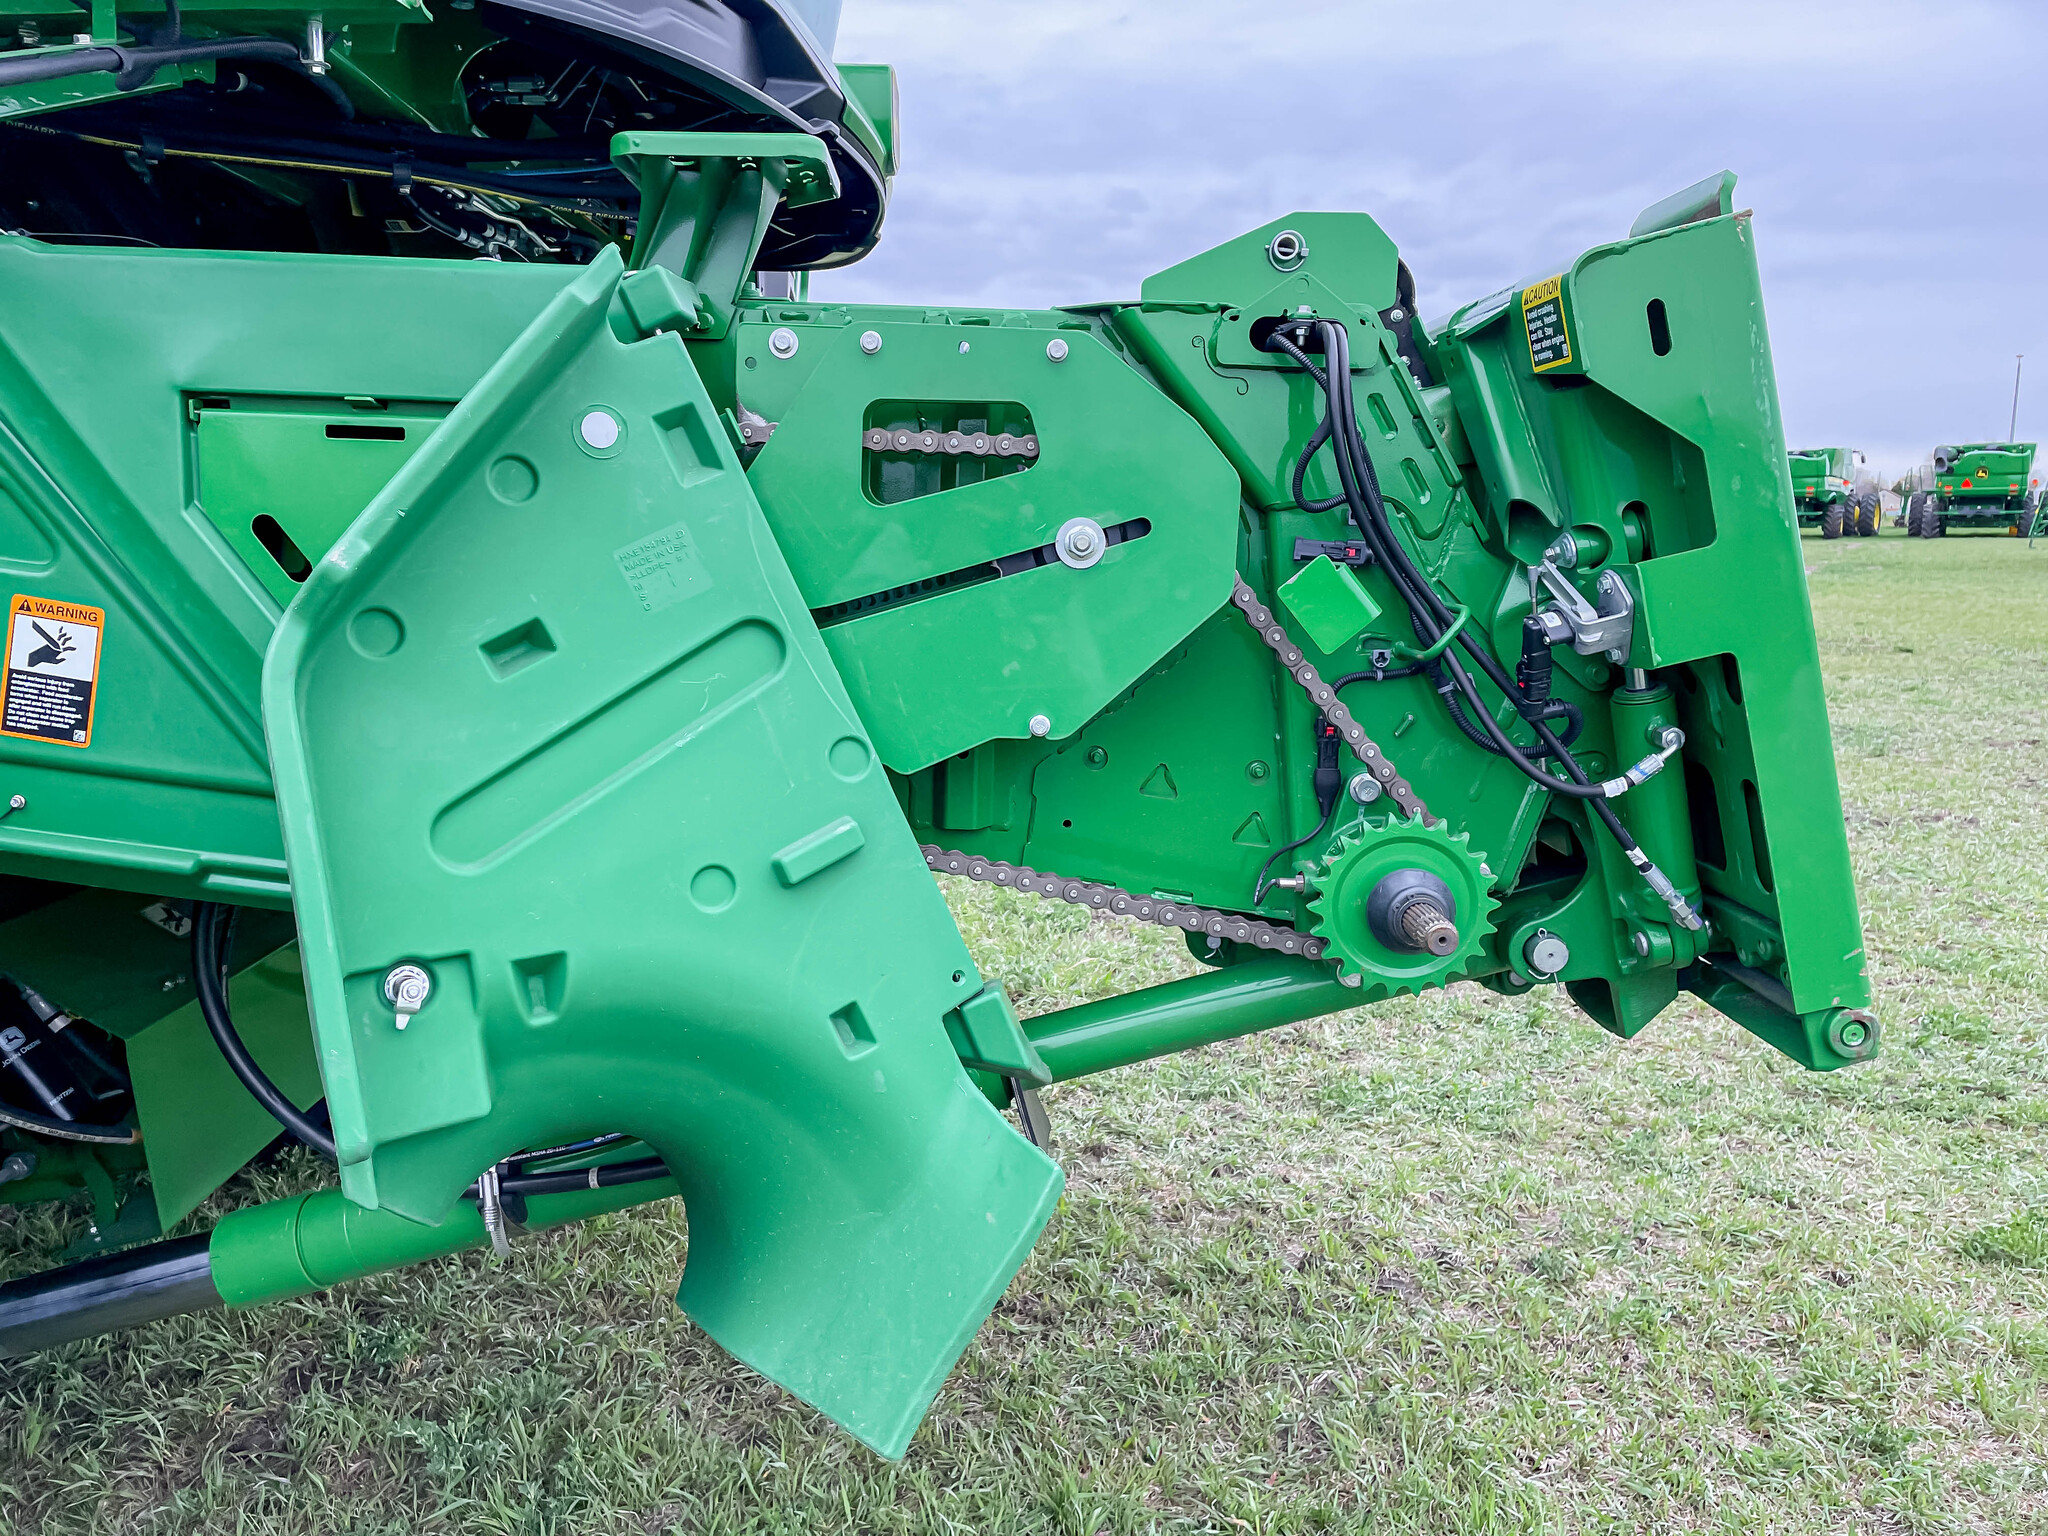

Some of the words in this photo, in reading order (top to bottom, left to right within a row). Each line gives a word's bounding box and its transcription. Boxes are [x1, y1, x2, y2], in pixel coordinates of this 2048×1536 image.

[1529, 279, 1558, 303] CAUTION
[1527, 309, 1537, 320] Avoid
[1538, 304, 1553, 315] crushing
[1544, 327, 1553, 336] Stay
[1542, 339, 1552, 348] when
[1552, 334, 1564, 345] engine
[1538, 350, 1553, 360] running.
[624, 555, 653, 572] MADE
[655, 550, 665, 558] IN
[666, 542, 687, 554] USA
[35, 602, 98, 621] WARNING
[11, 680, 45, 689] entanglement
[55, 693, 84, 701] accelerator
[2, 1052, 21, 1068] JOHN
[20, 1039, 41, 1053] DEERE
